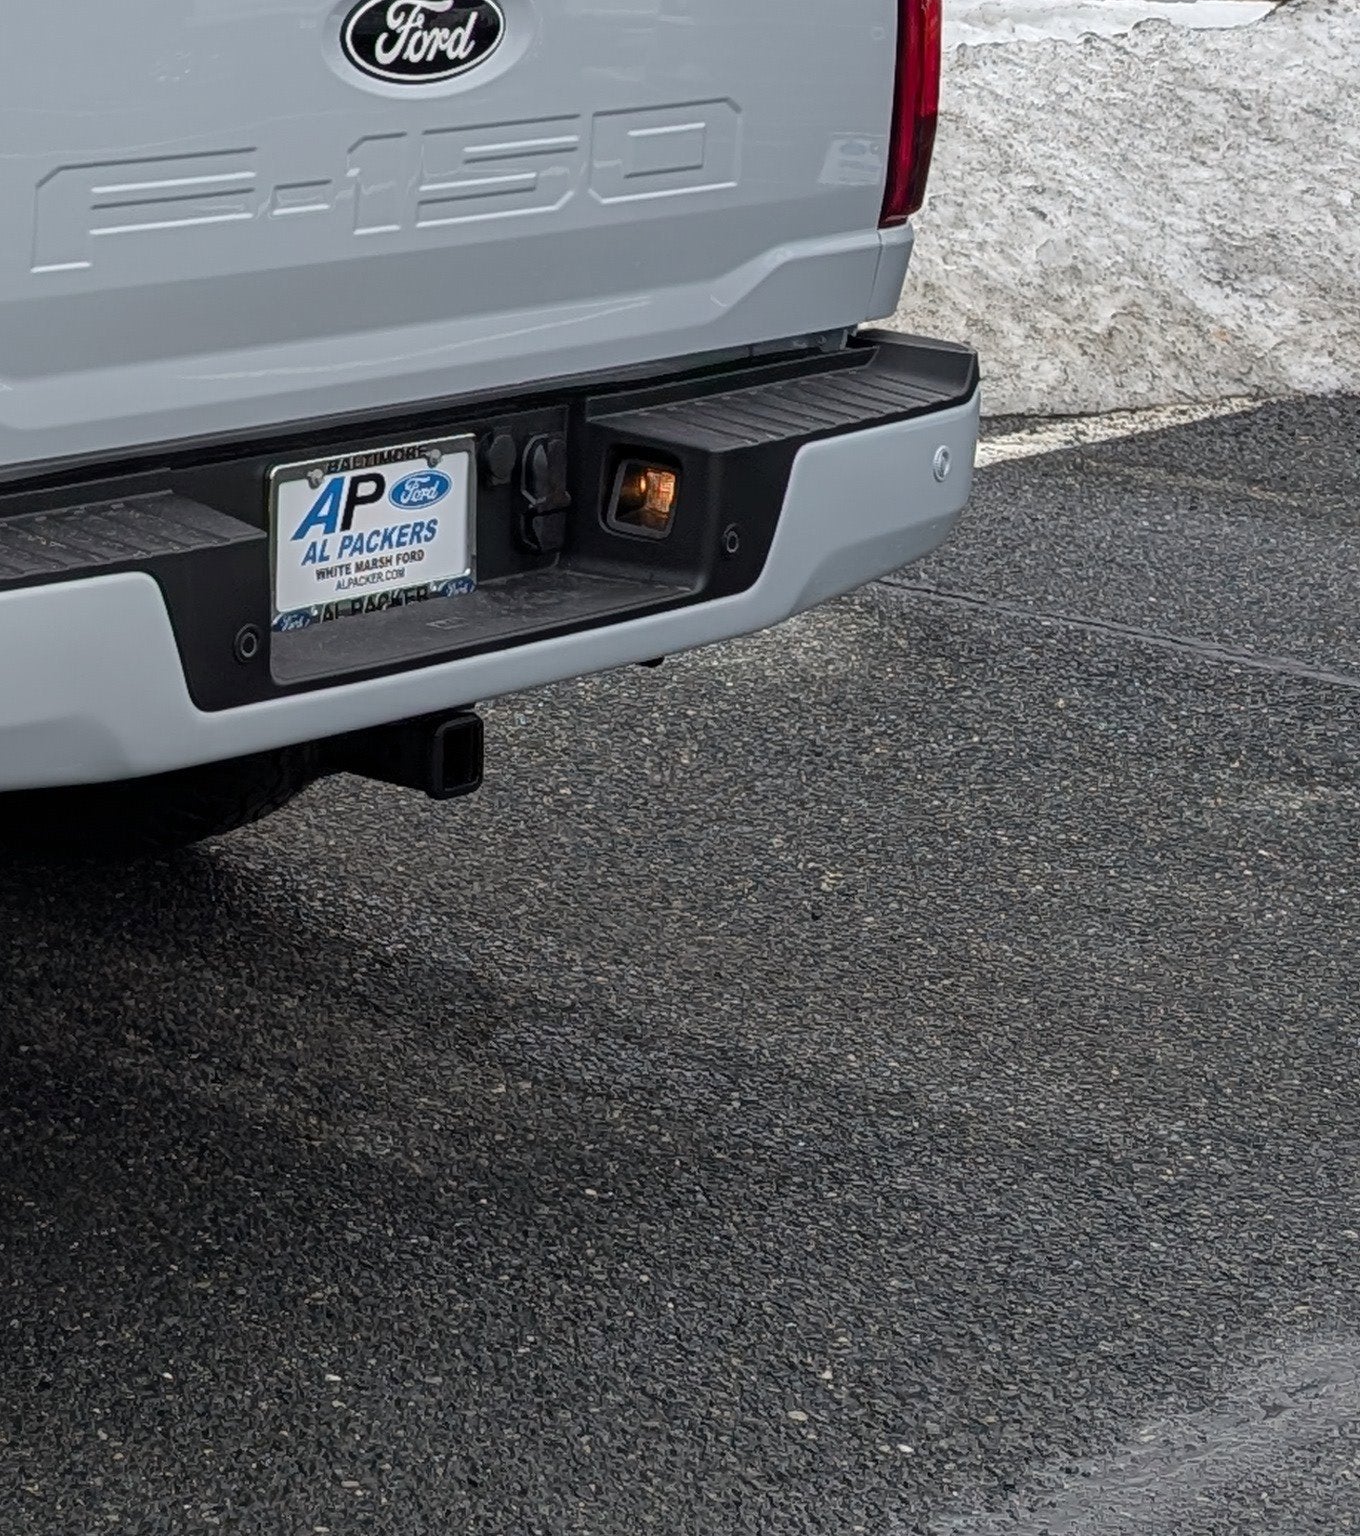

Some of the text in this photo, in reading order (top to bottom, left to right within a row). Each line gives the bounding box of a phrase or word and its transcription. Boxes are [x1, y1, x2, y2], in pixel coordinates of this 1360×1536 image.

[30, 96, 742, 272] F-150
[327, 445, 429, 470] BALTIMORE
[290, 473, 439, 541] AP Ford
[301, 519, 438, 565] AL PACKERS
[316, 549, 425, 581] WHITE MARSH FORD
[335, 567, 405, 591] ALPACKER.COM
